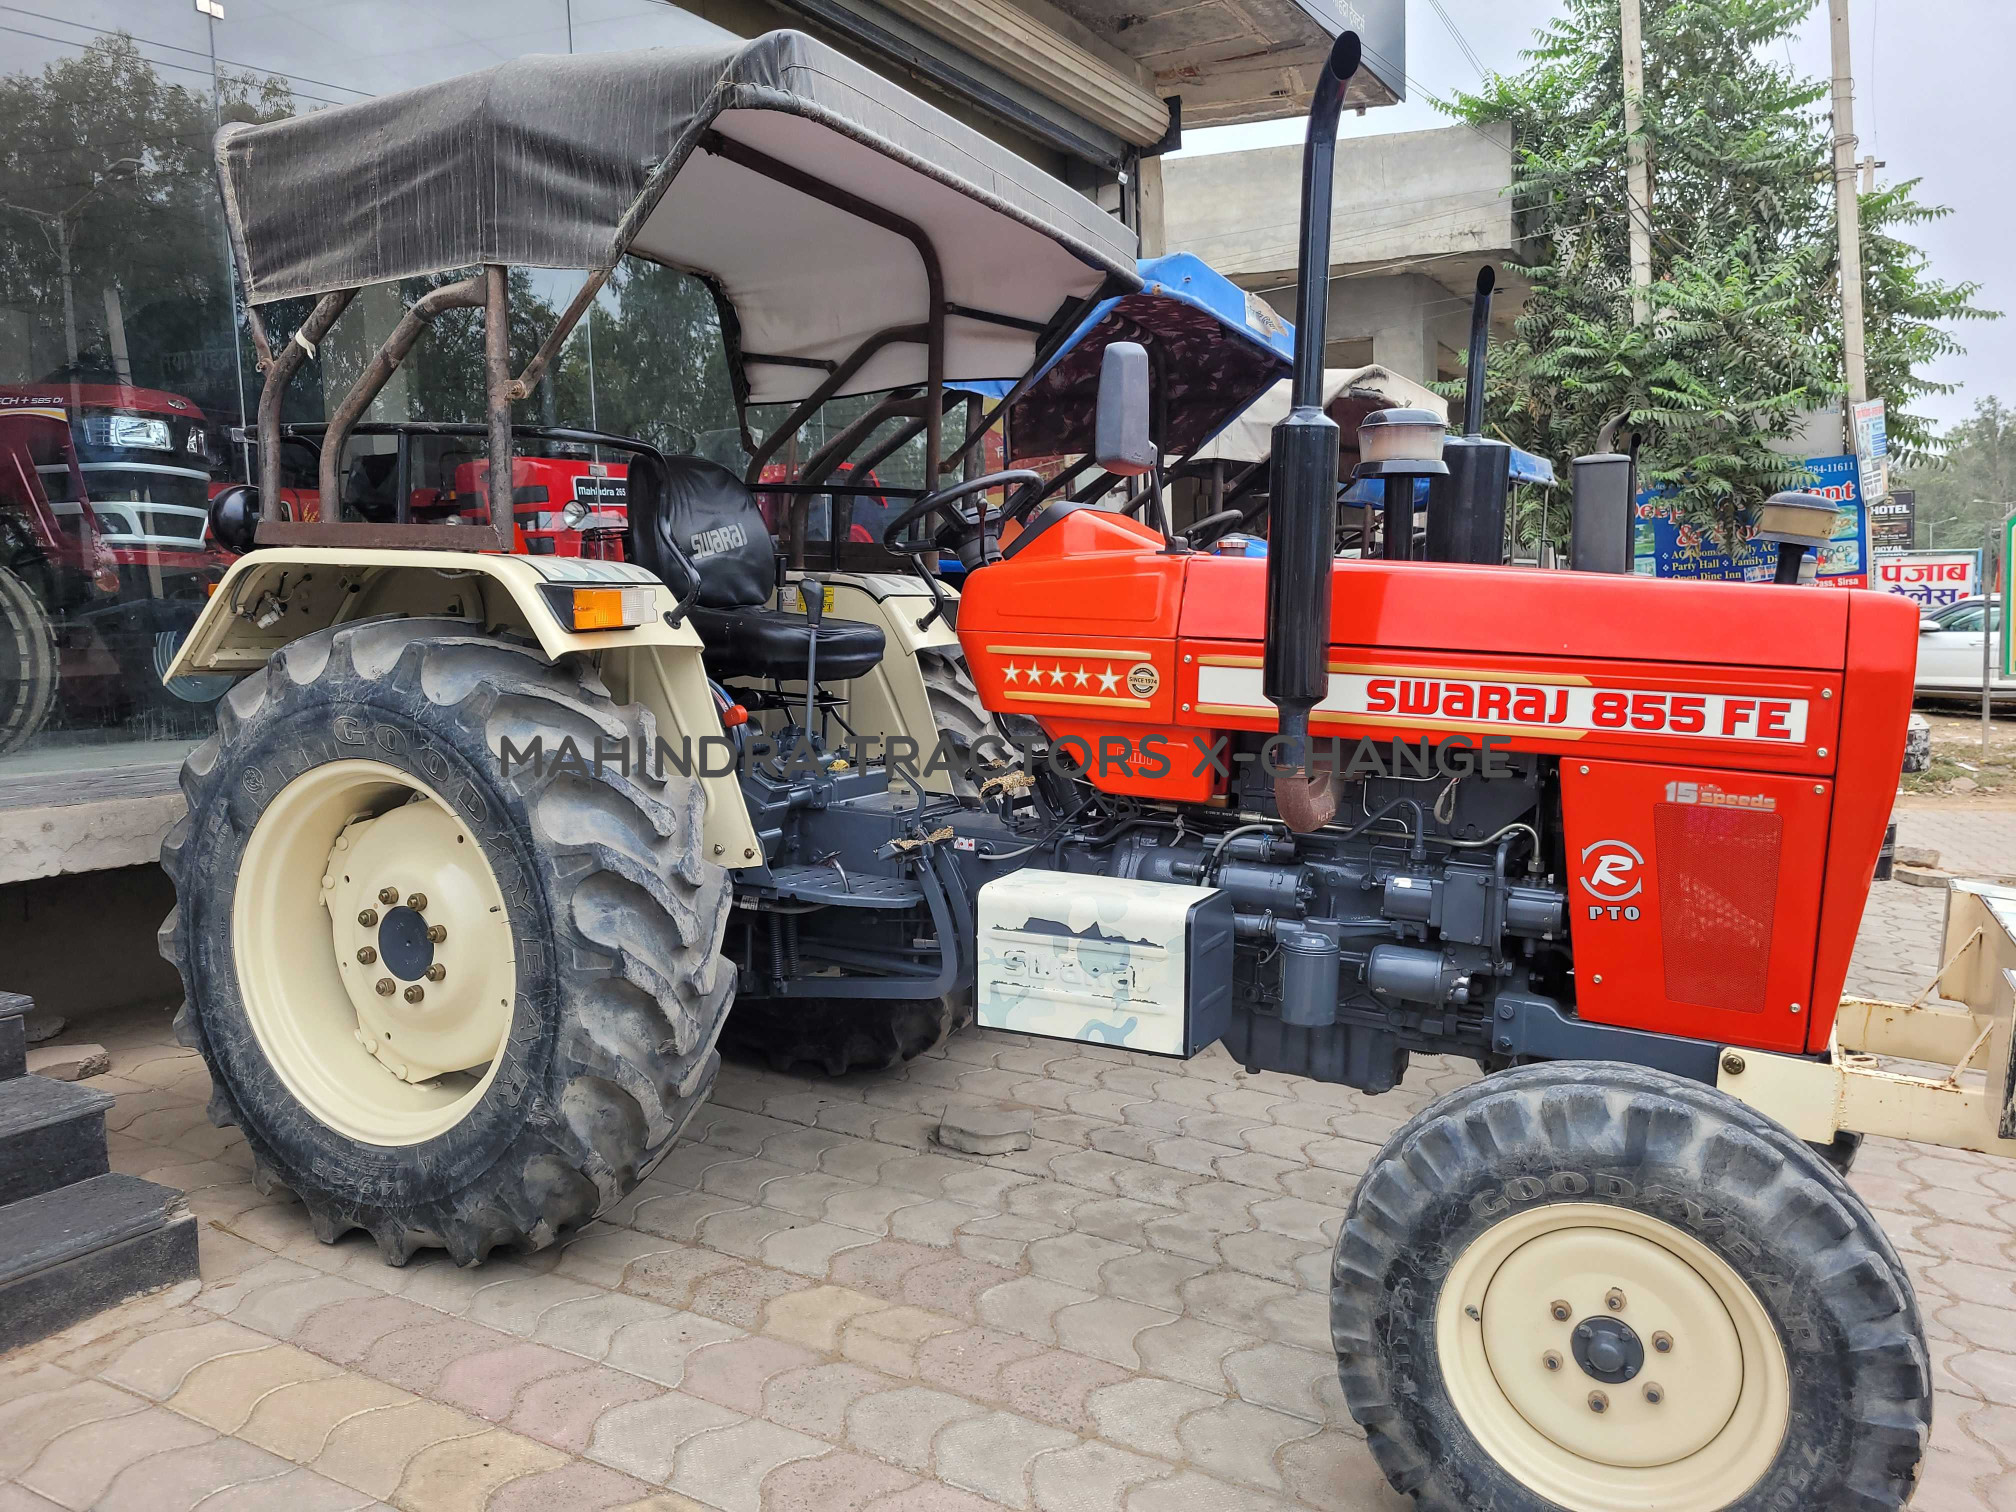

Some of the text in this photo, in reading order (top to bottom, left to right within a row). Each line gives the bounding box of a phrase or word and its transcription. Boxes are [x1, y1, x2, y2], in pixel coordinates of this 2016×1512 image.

[1871, 504, 1910, 515] HOTEL
[1760, 543, 1776, 553] AC
[1672, 562, 1697, 573] Party
[1699, 559, 1719, 569] Hall
[1732, 554, 1764, 567] Family
[1880, 558, 1970, 583] पंजाब
[1700, 572, 1722, 580] Dine
[1725, 570, 1741, 579] Inn
[1837, 577, 1859, 586] Sirsa
[1591, 692, 1705, 733] 855
[1722, 700, 1792, 739] FE
[1665, 781, 1698, 804] 15
[1588, 906, 1640, 921] PTO
